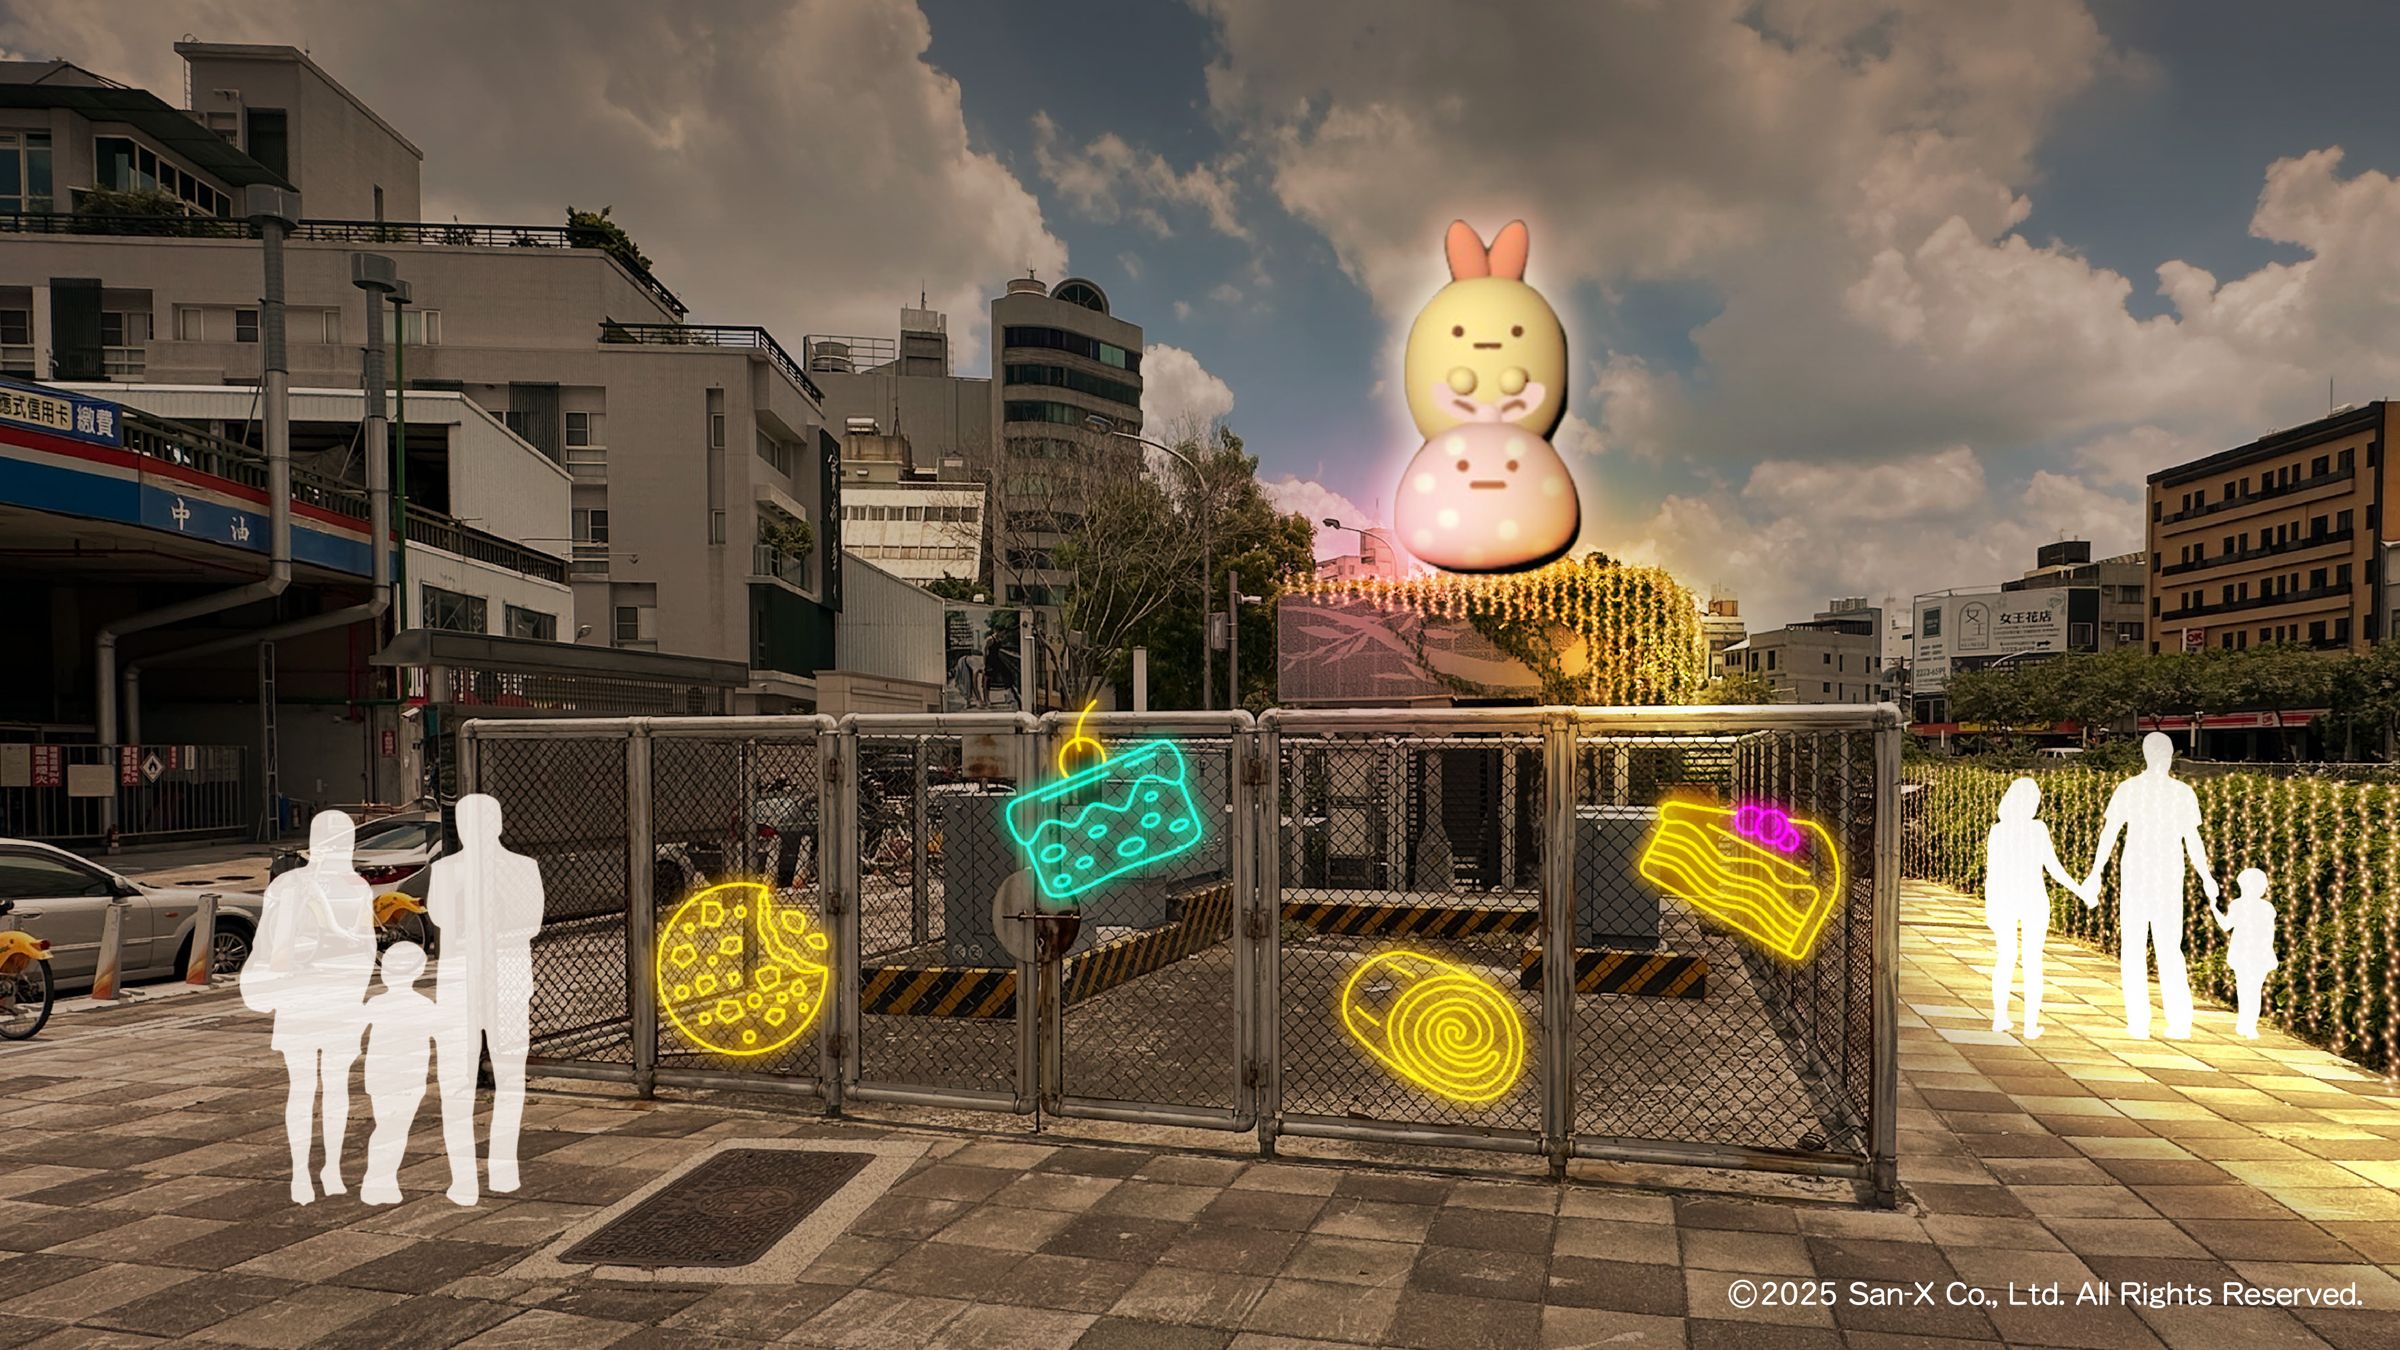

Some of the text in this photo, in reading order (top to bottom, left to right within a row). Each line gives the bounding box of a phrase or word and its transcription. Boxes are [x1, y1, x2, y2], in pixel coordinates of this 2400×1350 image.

[170, 497, 250, 542] 中油
[1999, 610, 2052, 625] 女王花店
[2187, 631, 2203, 642] OK
